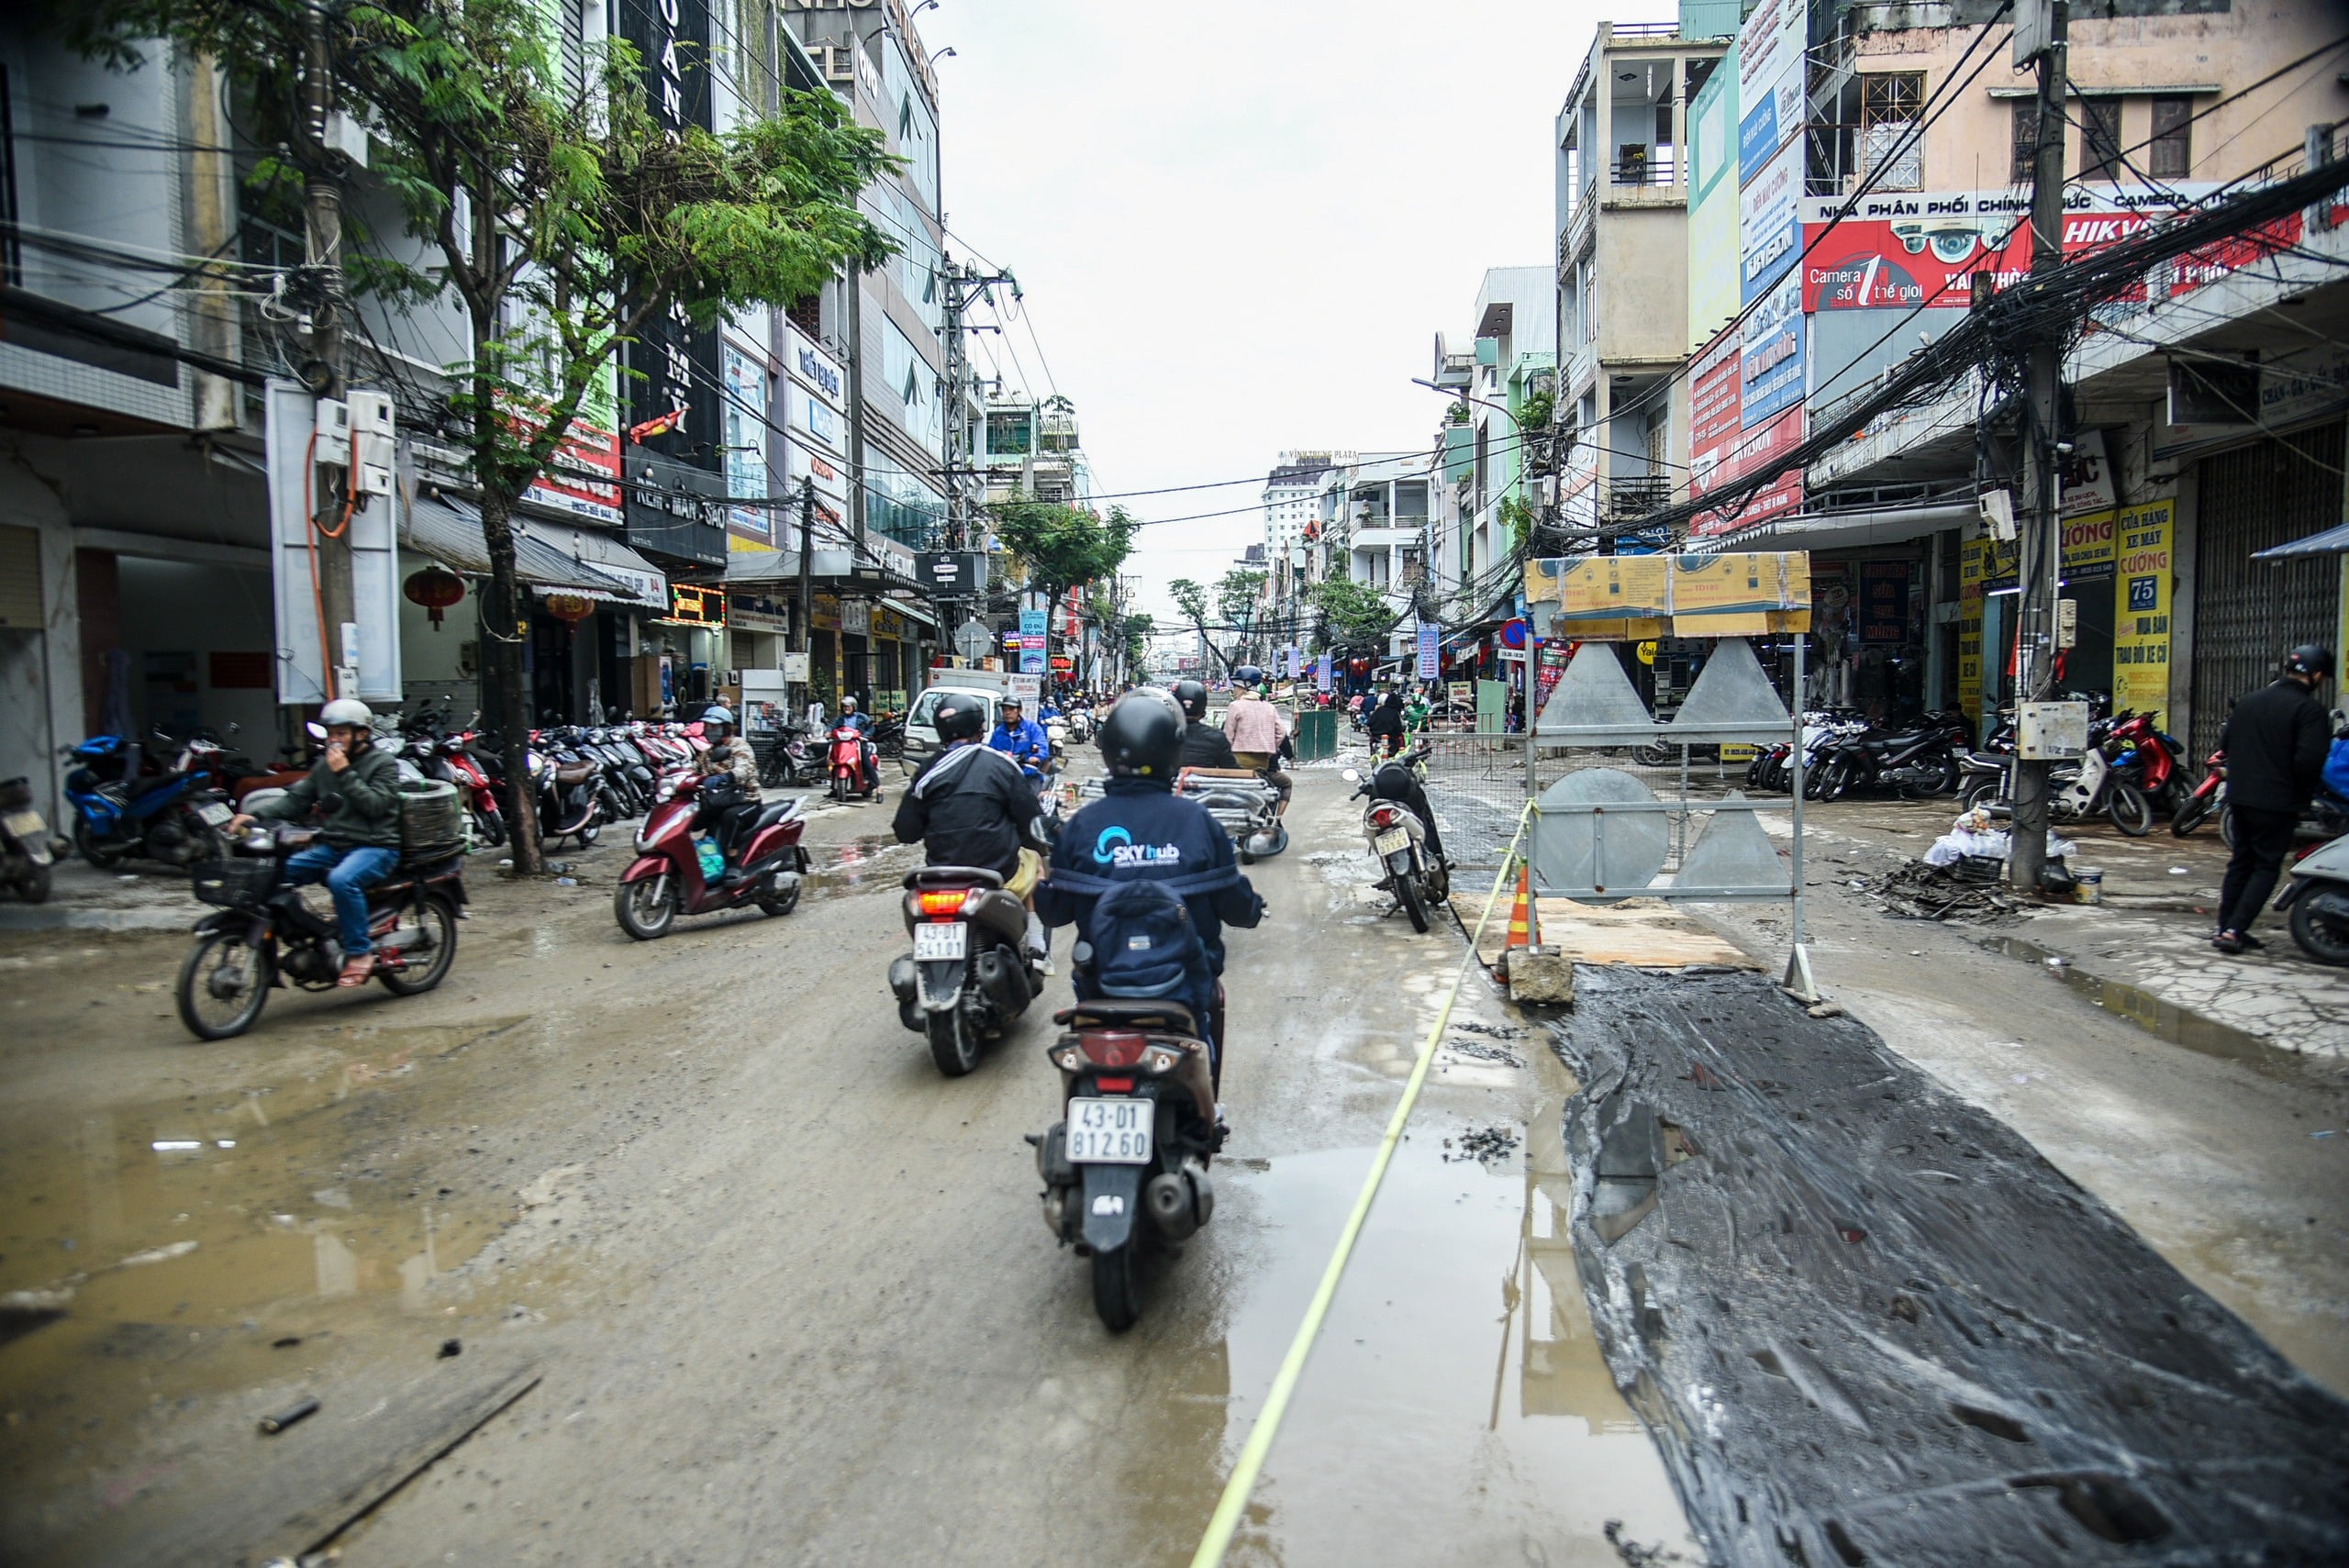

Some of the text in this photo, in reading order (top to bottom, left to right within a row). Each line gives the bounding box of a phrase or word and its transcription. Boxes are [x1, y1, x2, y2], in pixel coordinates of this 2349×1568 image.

[1868, 199, 1919, 216] PHÂN
[1927, 195, 1969, 214] PHỐI
[2114, 194, 2189, 208] CAMERA
[1810, 268, 1861, 284] Camera
[1859, 254, 1881, 306] 1
[1837, 284, 1854, 301] số
[1334, 450, 1357, 459] PLAZA
[2121, 506, 2168, 530] CỬA HÀNG
[2126, 527, 2162, 549] XE MÁY
[2121, 550, 2167, 574] CƯỜNG
[2132, 580, 2154, 601] 75
[2147, 645, 2155, 663] XE
[1113, 842, 1180, 862] SKY hub
[1082, 1104, 1137, 1129] 43-D1
